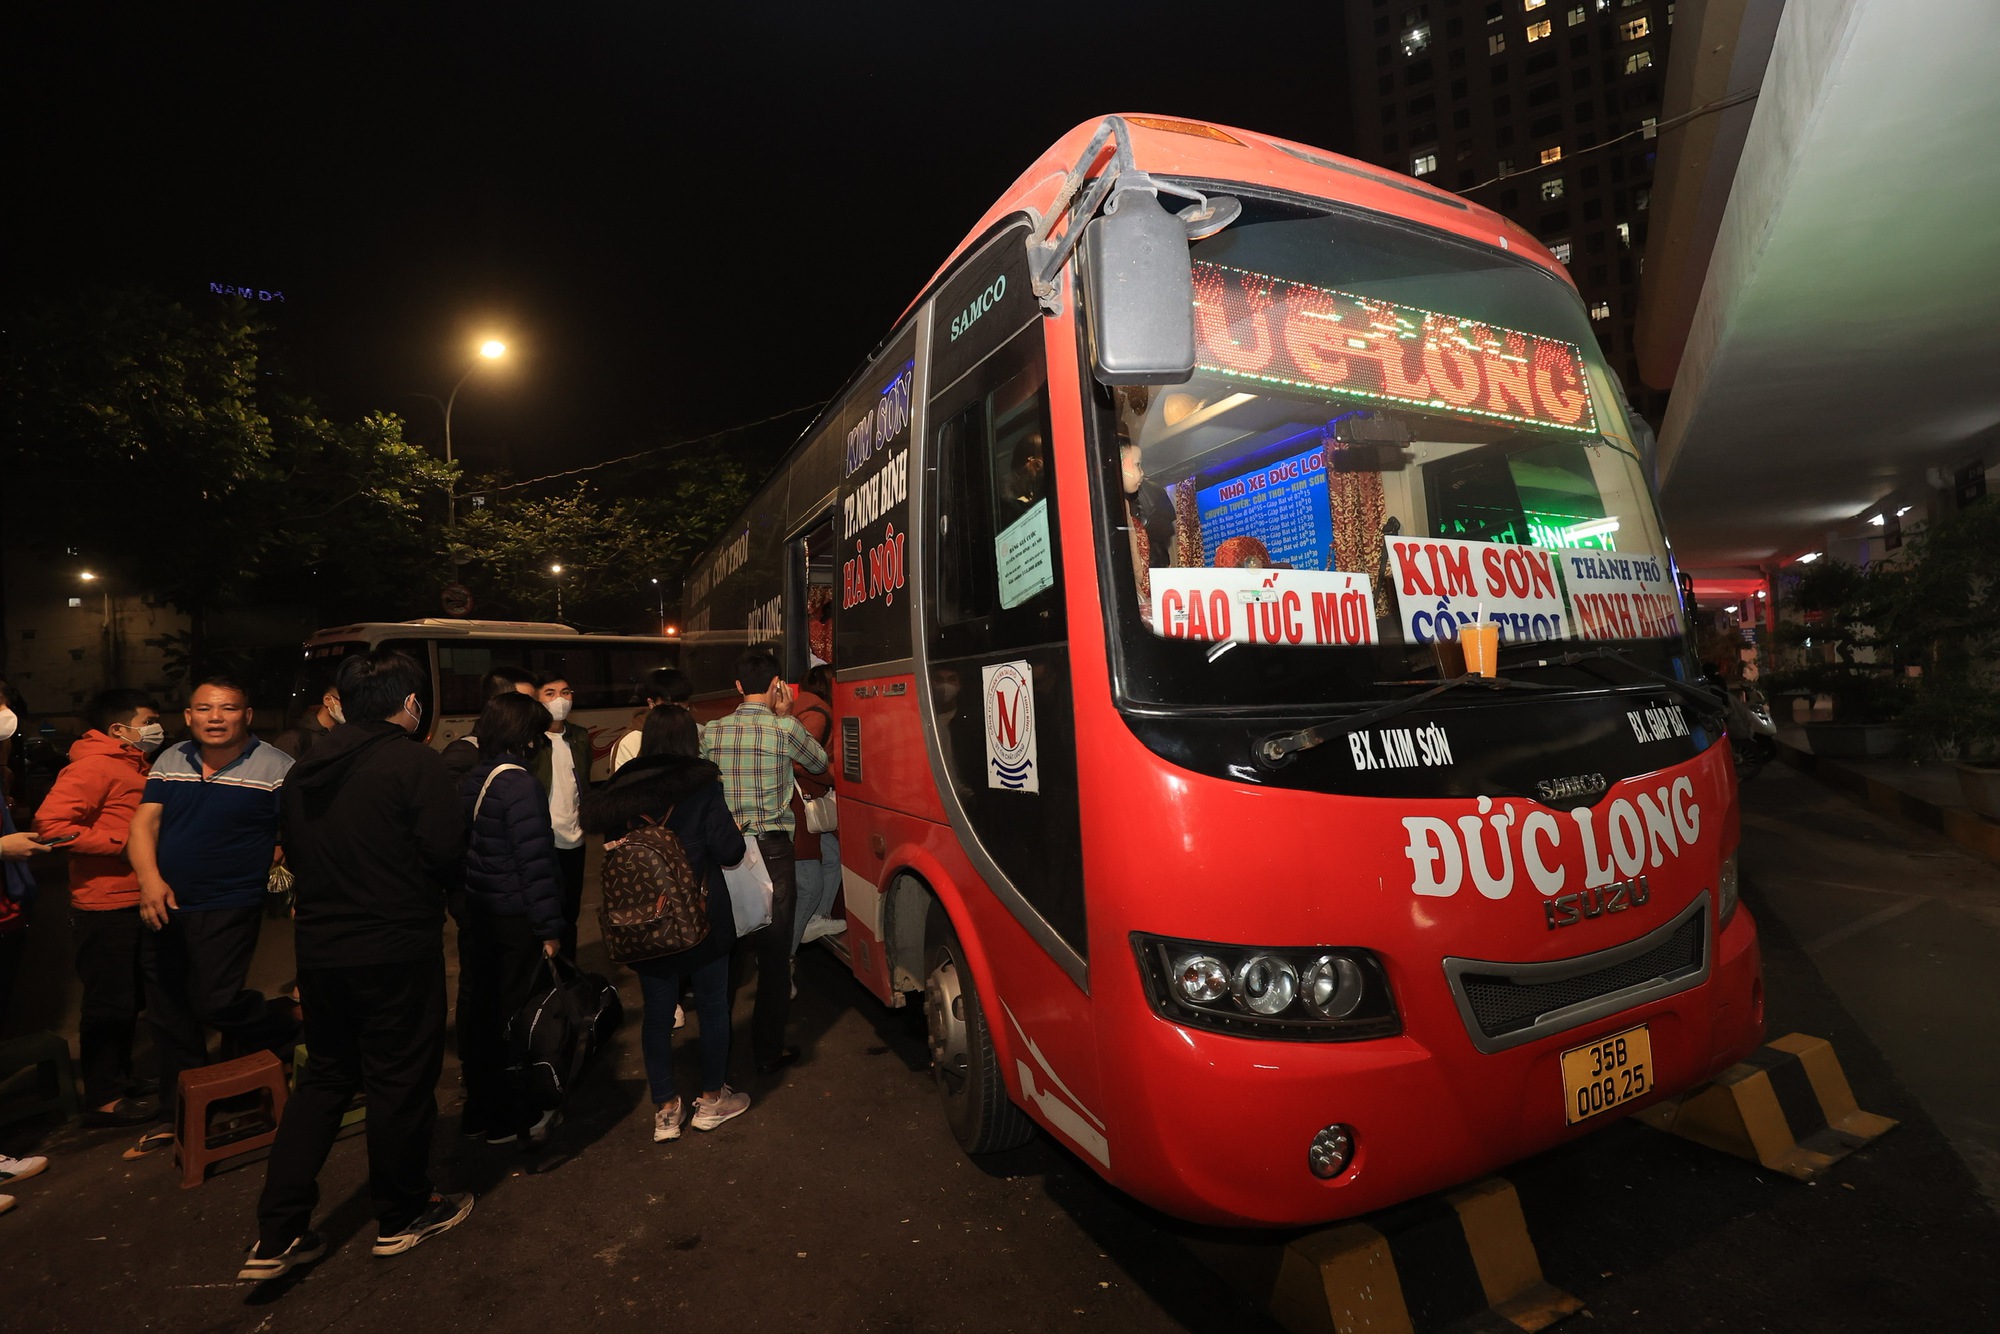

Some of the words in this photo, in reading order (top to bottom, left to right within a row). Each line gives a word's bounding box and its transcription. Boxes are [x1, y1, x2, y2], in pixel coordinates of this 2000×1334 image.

[951, 274, 1006, 342] SAMCO
[846, 409, 873, 479] KIM
[876, 370, 912, 451] SƠN
[880, 449, 908, 517] BÌNH
[1219, 479, 1246, 502] NHÀ
[1248, 474, 1266, 493] XE
[1269, 462, 1299, 485] ĐỨC
[842, 539, 866, 610] HÀ
[869, 522, 905, 607] NỘI
[1393, 543, 1478, 597] KIM
[1482, 545, 1556, 599] SƠN
[1571, 552, 1636, 582] THÀNH
[1634, 555, 1661, 582] PHỐ
[762, 594, 782, 642] LONG
[1161, 589, 1232, 642] CAO
[1312, 577, 1371, 645] MỚI
[1573, 593, 1637, 641] NINH
[1632, 582, 1681, 639] BÌNH
[1416, 721, 1454, 767] SƠN
[1667, 698, 1690, 737] BÁT
[1536, 773, 1607, 800] SAMCO
[1401, 795, 1566, 900] ĐỨC
[1570, 776, 1700, 890] LONG
[1543, 875, 1650, 930] ISUZU
[1589, 1038, 1627, 1077] 35B
[1577, 1064, 1645, 1117] 008.25
